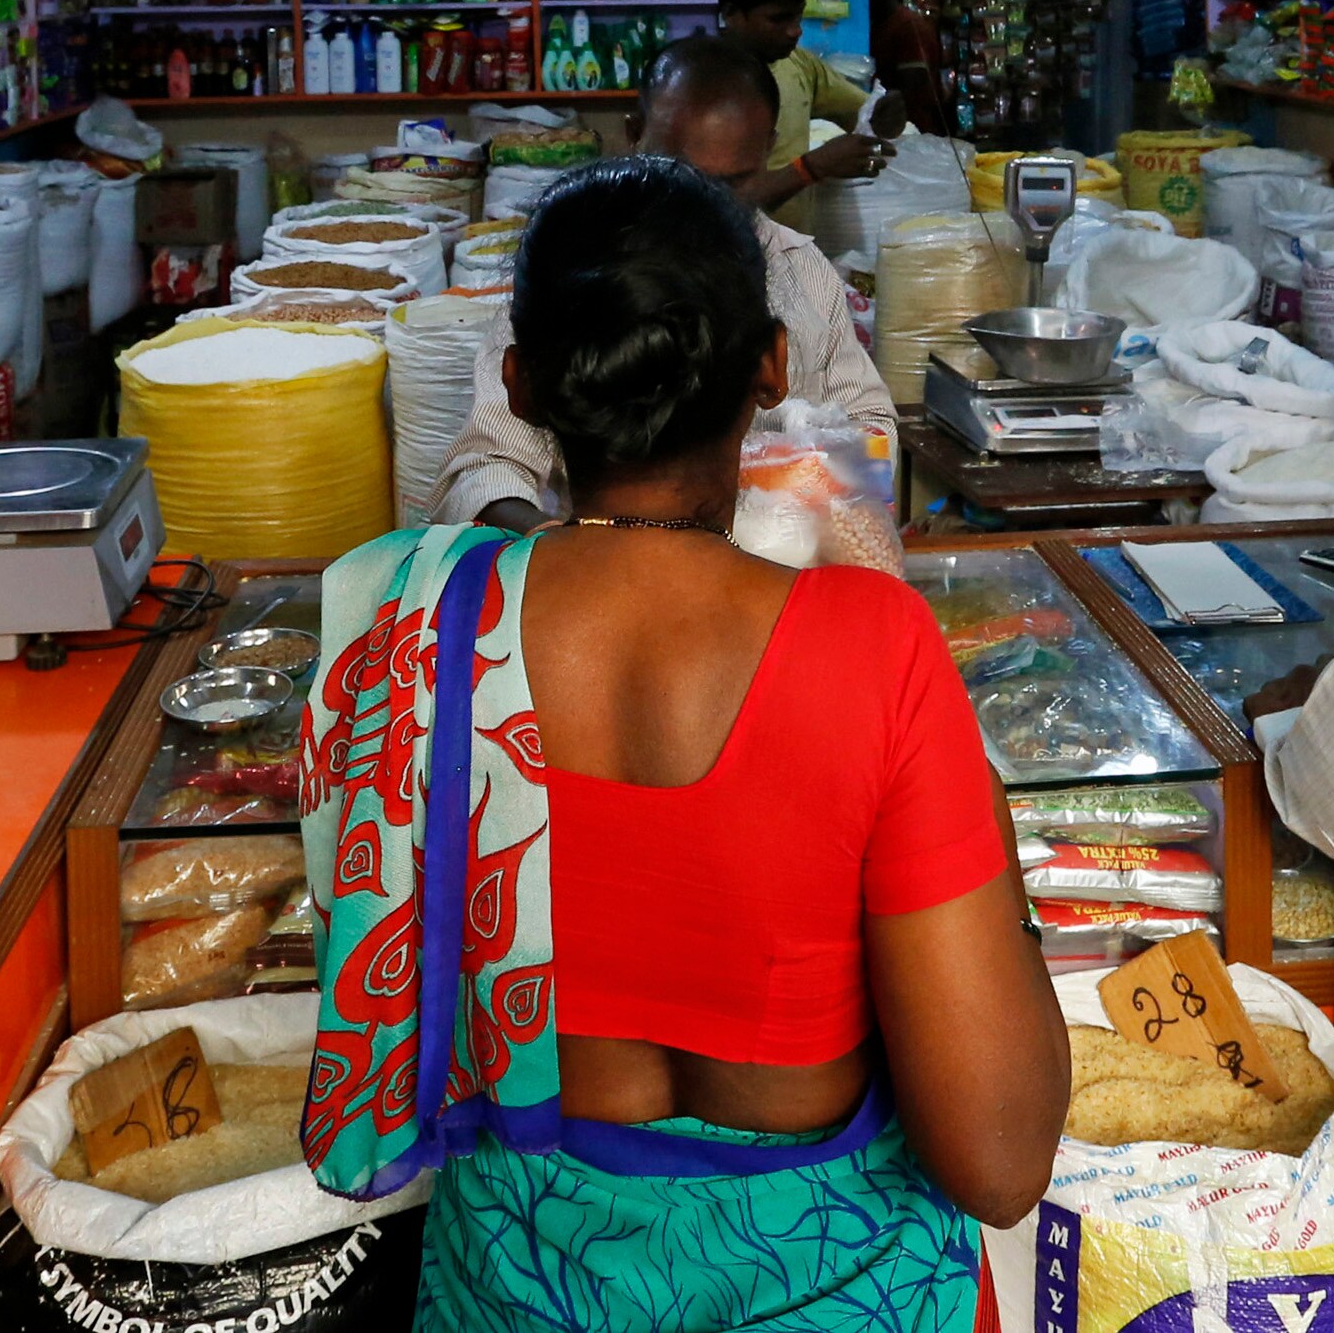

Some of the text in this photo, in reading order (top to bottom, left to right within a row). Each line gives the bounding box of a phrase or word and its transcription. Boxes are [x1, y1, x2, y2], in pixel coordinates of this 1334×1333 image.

[1133, 154, 1184, 173] SOYA
[1077, 845, 1160, 861] 25% EXTRA
[1132, 971, 1207, 1044] 28
[1053, 1168, 1098, 1190] MAYUR
[1114, 1184, 1161, 1206] MAYUR
[1186, 1187, 1229, 1214] MAYUR
[40, 1263, 166, 1333] SYMBOL
[245, 1221, 383, 1333] QUALITY
